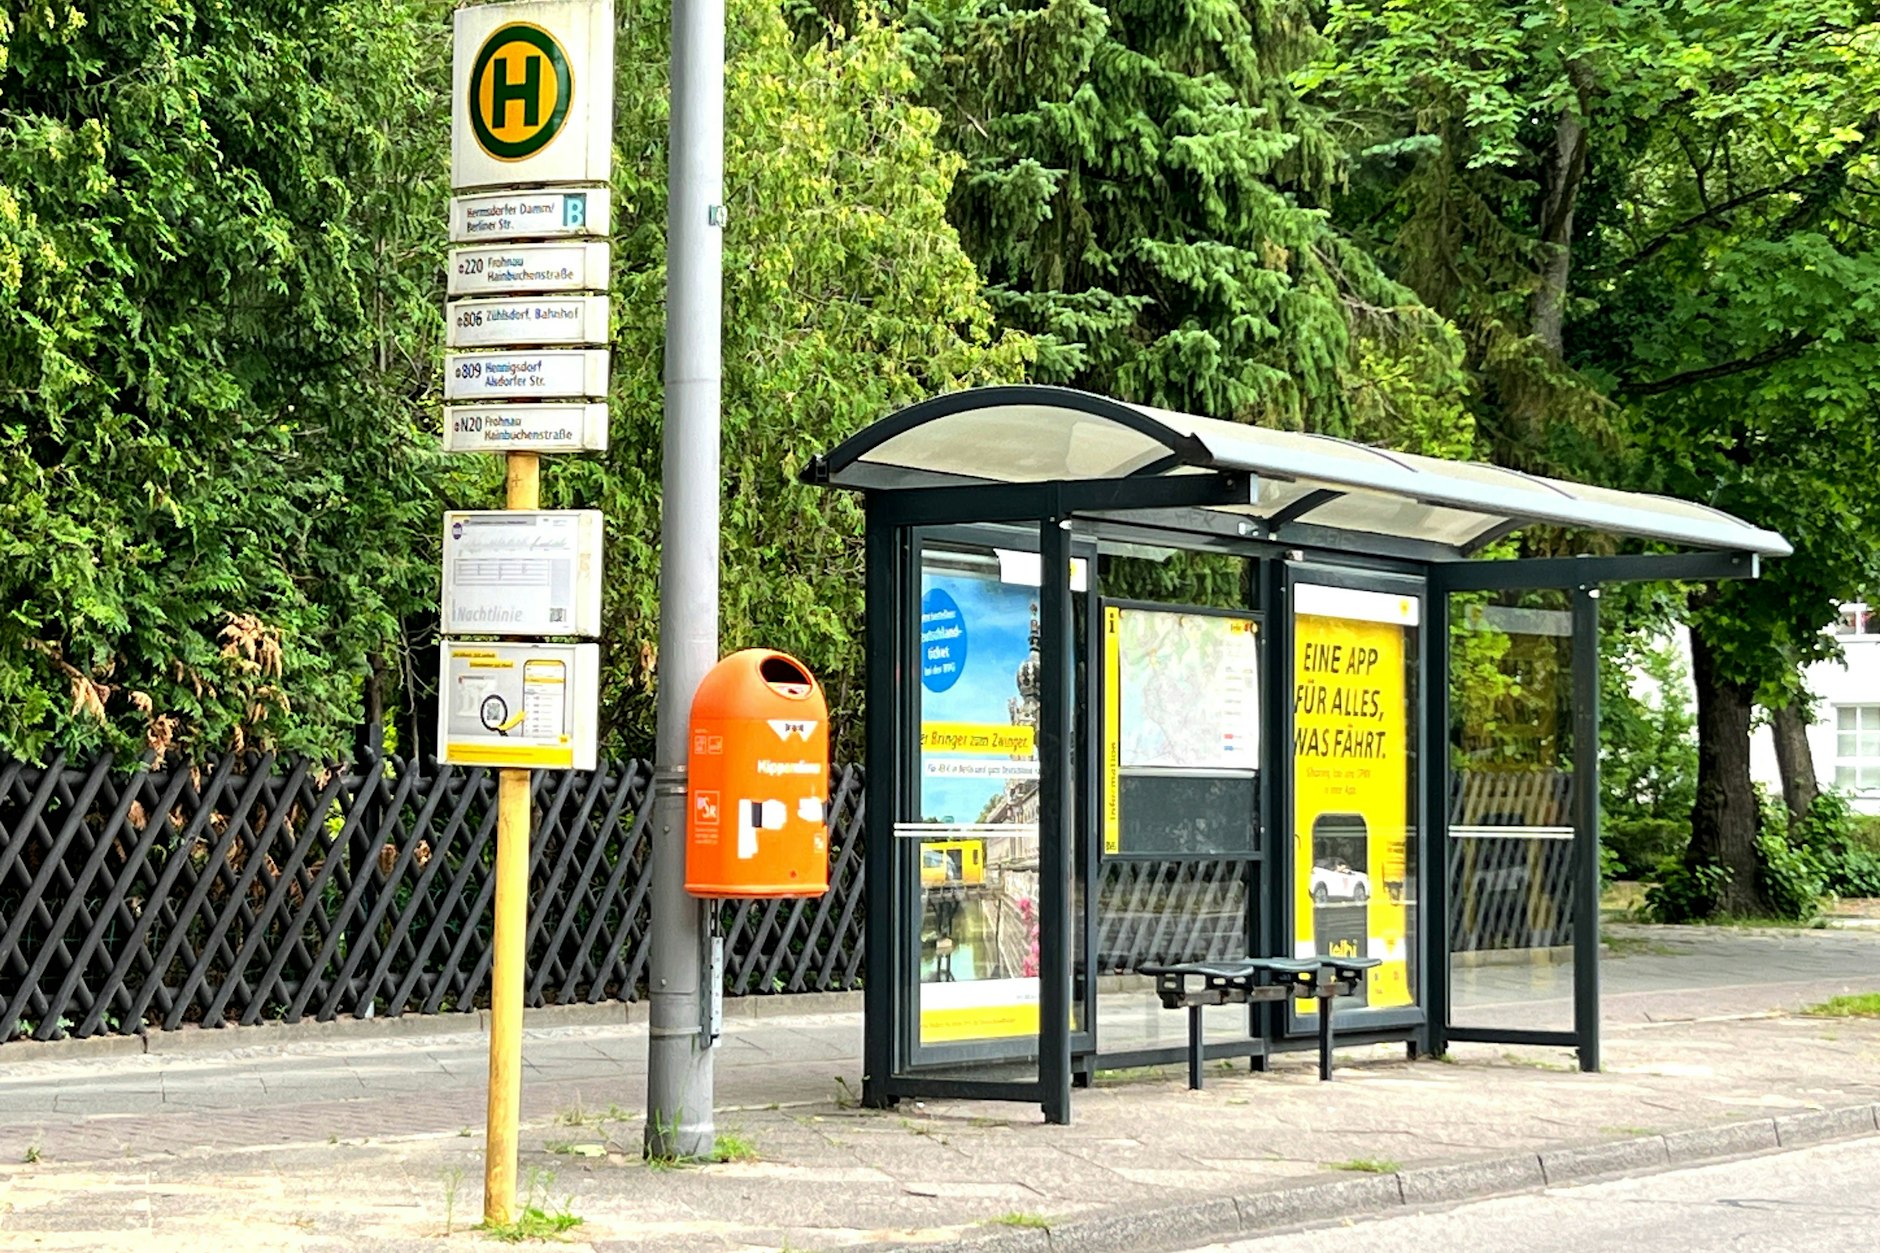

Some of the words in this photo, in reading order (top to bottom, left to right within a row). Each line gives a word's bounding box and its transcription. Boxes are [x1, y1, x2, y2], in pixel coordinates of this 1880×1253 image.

[491, 55, 541, 129] H
[466, 220, 496, 233] Berliner
[498, 218, 515, 230] Str.
[465, 258, 484, 275] 220
[463, 311, 483, 328] 806
[535, 307, 579, 320] Bahnhof
[462, 362, 482, 379] 809
[529, 374, 546, 387] Str.
[461, 416, 483, 432] N20
[456, 605, 524, 623] Nachtlinie
[1303, 642, 1342, 674] EINE
[1345, 646, 1379, 675] APP
[1294, 679, 1327, 715] FÜR
[1331, 687, 1384, 722] ALLES,
[931, 731, 968, 750] Bringer
[1333, 723, 1387, 760] FÄHRT.
